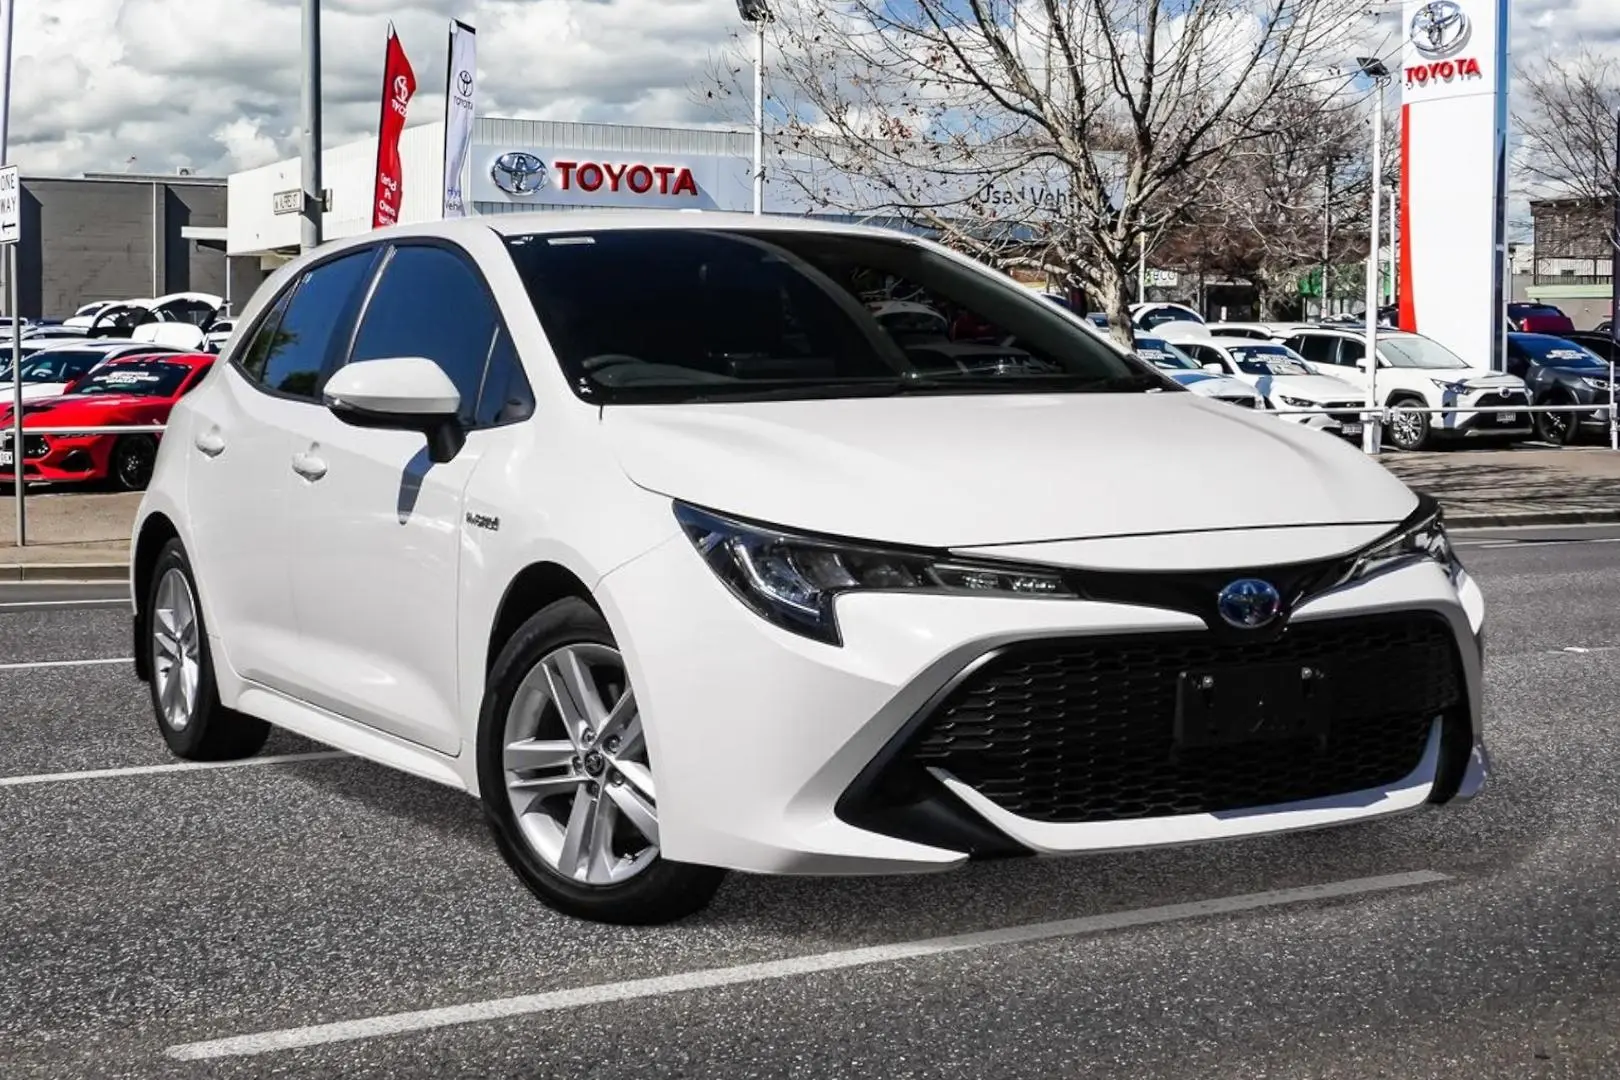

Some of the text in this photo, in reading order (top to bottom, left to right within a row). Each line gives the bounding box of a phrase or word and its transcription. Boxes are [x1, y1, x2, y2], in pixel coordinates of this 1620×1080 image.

[1404, 58, 1480, 83] TOYOTA
[1, 173, 15, 191] ONE
[555, 161, 698, 196] TOYOTA
[0, 196, 16, 214] WAY
